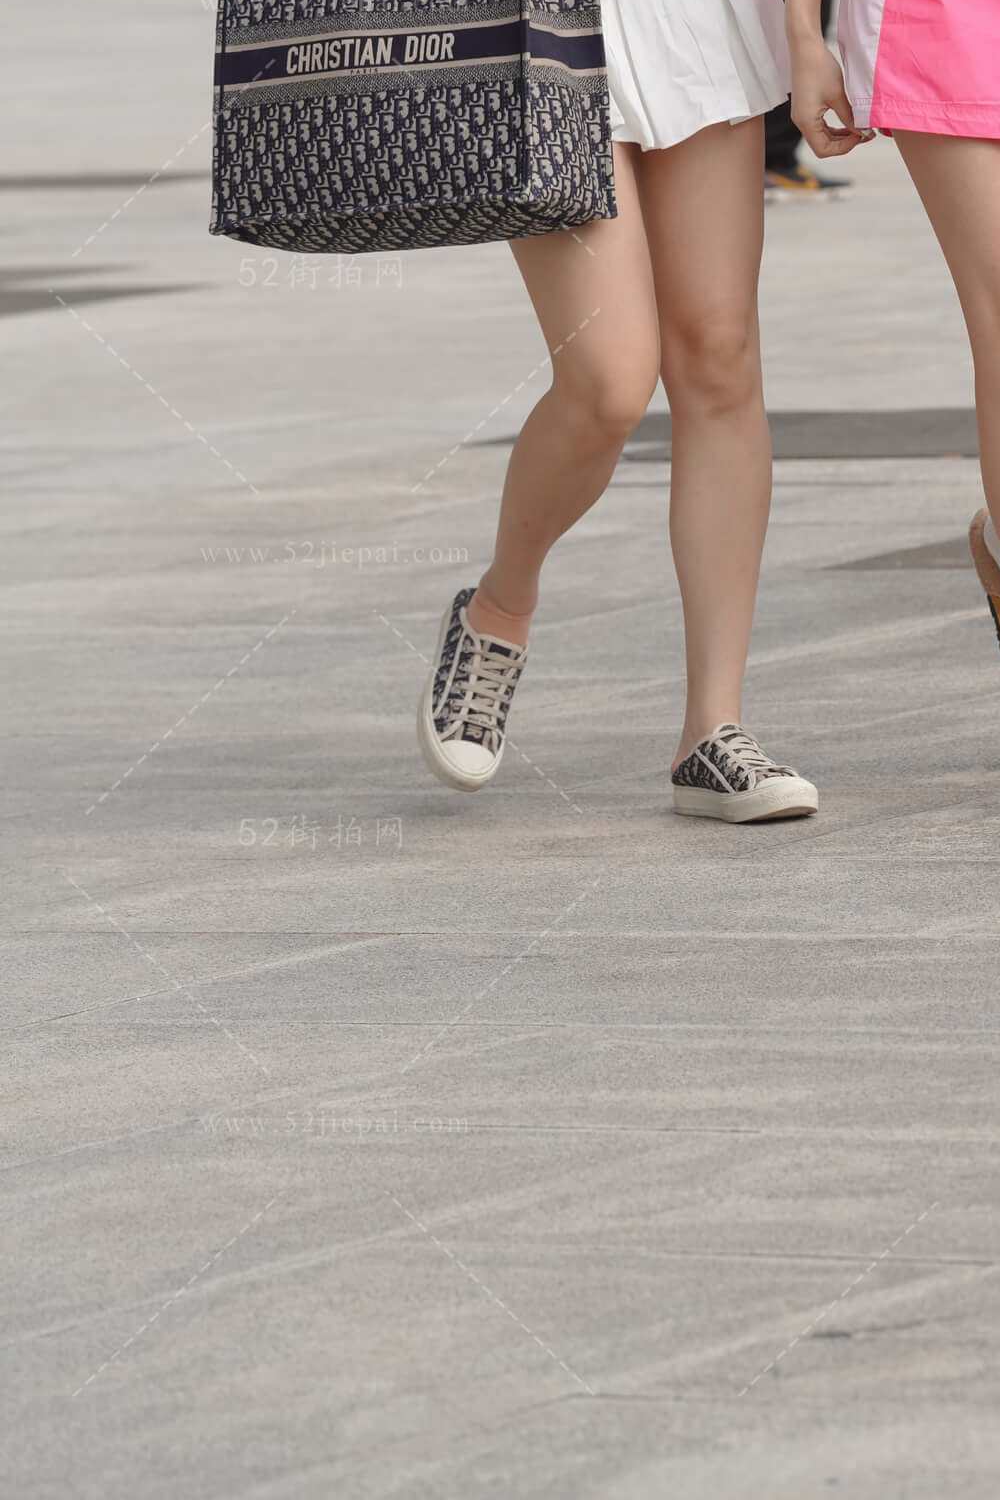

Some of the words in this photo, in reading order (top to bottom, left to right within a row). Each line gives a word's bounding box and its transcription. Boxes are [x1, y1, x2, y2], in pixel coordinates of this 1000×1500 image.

[286, 37, 393, 76] CHRISTIAN
[404, 32, 455, 64] DIOR
[350, 67, 379, 75] PARIS
